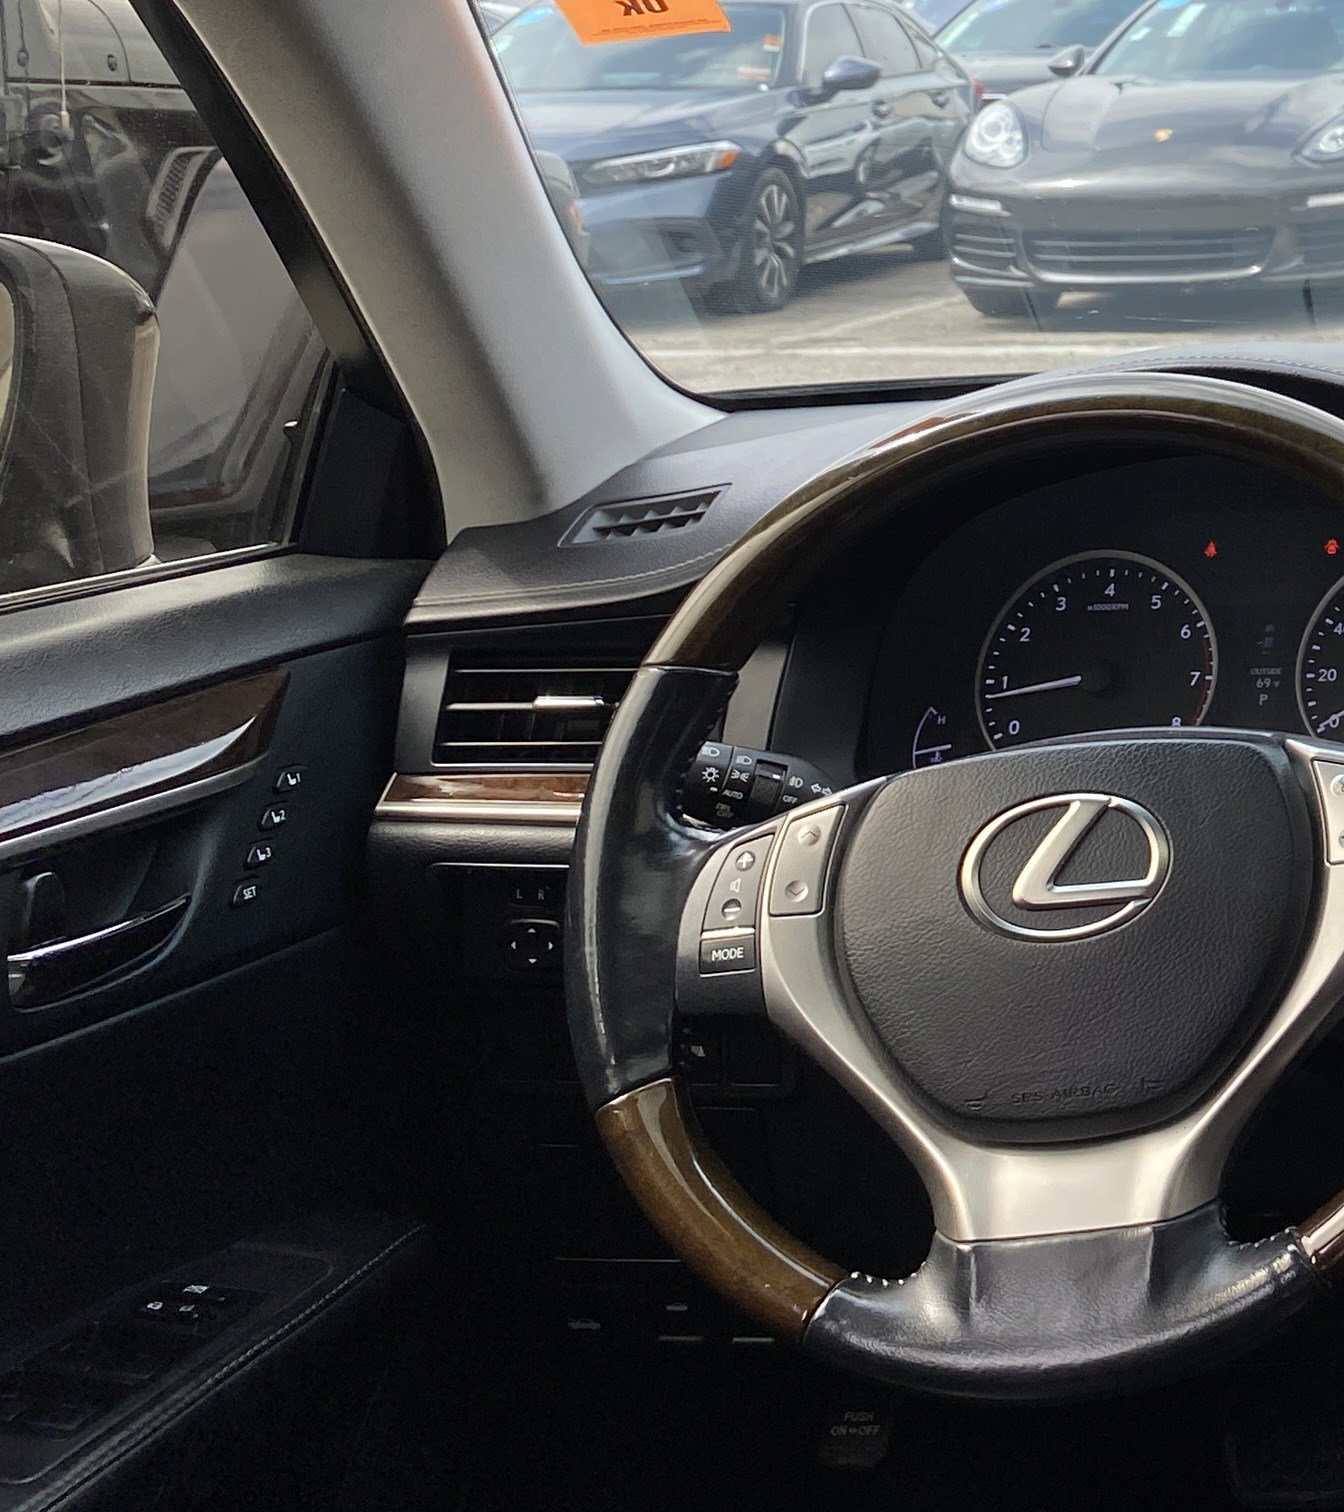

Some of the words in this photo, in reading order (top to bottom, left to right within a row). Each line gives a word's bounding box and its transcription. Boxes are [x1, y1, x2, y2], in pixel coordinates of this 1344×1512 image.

[1104, 582, 1116, 597] 4
[1055, 597, 1067, 611] 3
[1150, 595, 1162, 610] 5
[1019, 627, 1031, 643] 2
[1179, 624, 1192, 639] 6
[1189, 671, 1201, 686] 7
[1318, 668, 1338, 682] 20
[1001, 675, 1009, 690] 1
[1258, 693, 1269, 706] P
[1008, 720, 1020, 735] 0
[1329, 713, 1340, 728] 0
[721, 788, 744, 801] AUTO
[782, 794, 799, 804] OFF
[280, 809, 286, 821] 2
[265, 847, 272, 859] 3
[242, 886, 257, 900] SET
[516, 888, 523, 899] L
[537, 888, 545, 900] R
[711, 946, 745, 962] MODE
